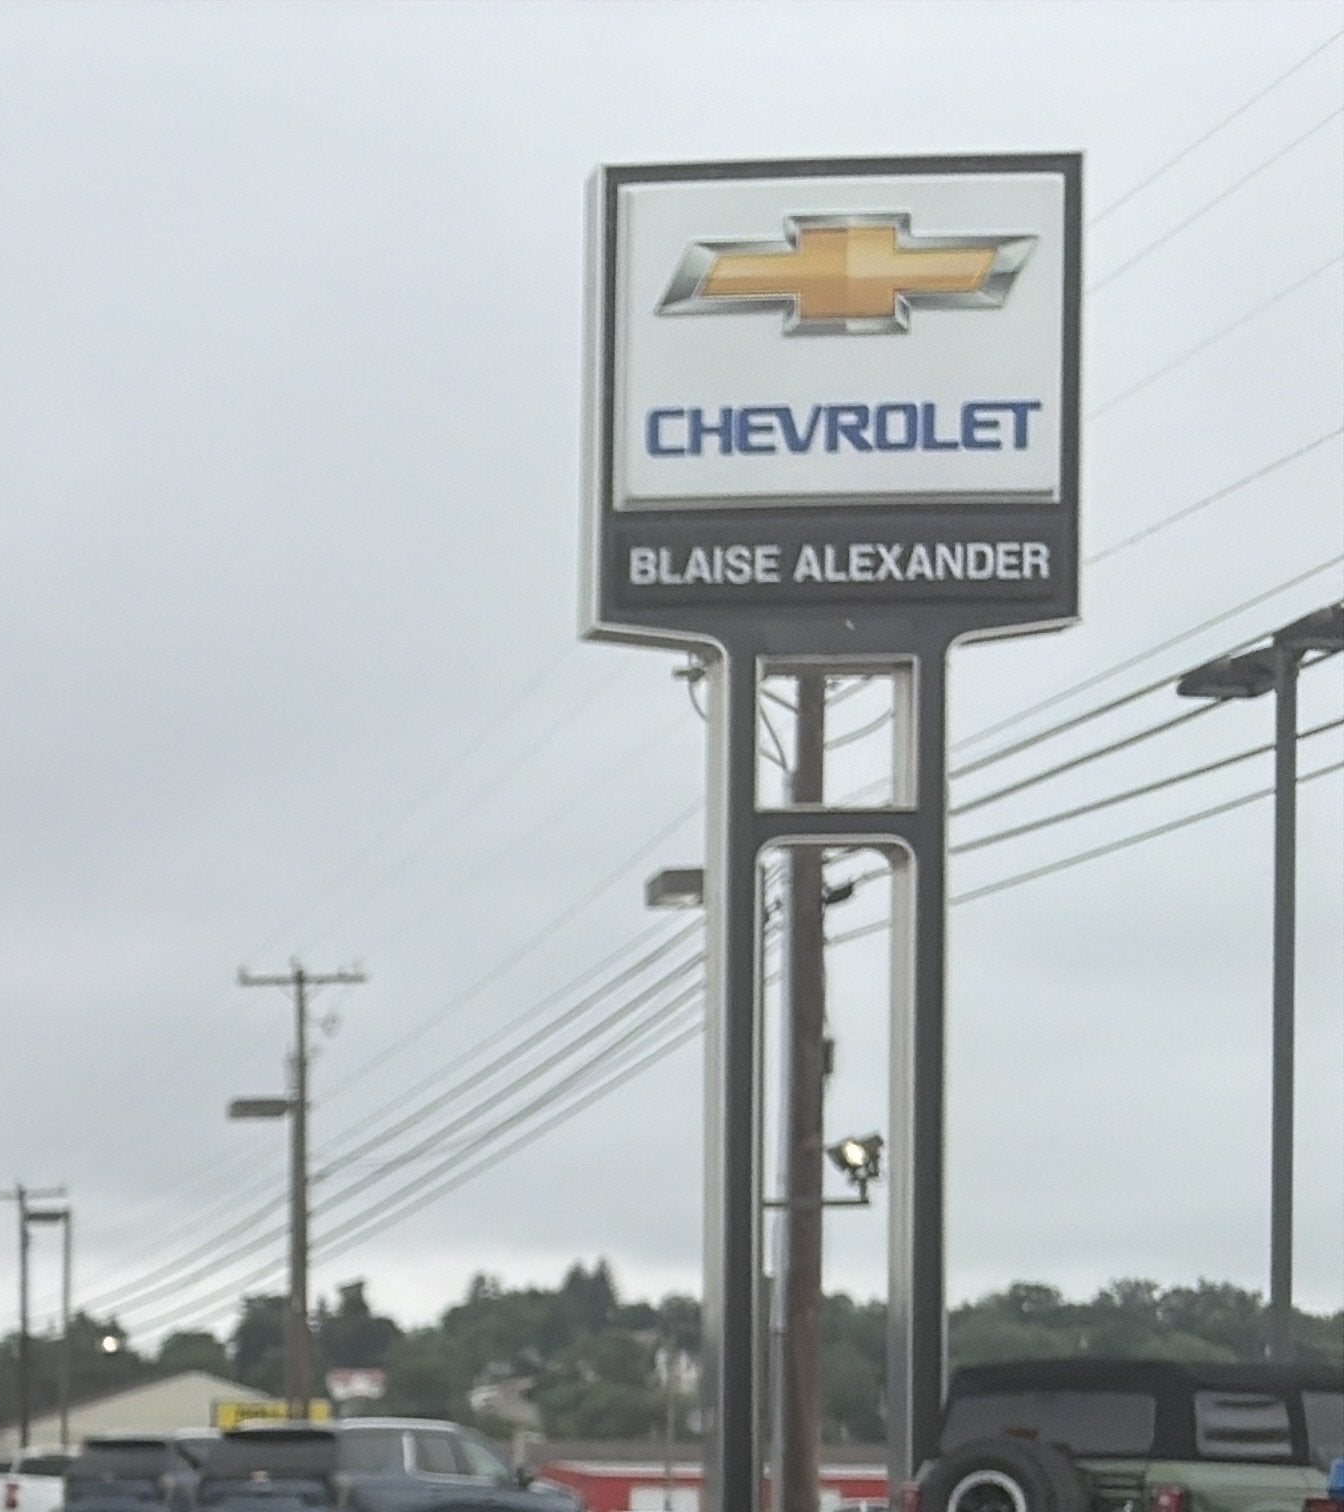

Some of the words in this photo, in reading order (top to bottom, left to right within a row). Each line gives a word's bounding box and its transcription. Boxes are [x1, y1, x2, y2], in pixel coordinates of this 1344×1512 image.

[647, 402, 1042, 456] CHEVROLET
[629, 545, 781, 584] BLAISE
[792, 541, 1050, 583] ALEXANDER
